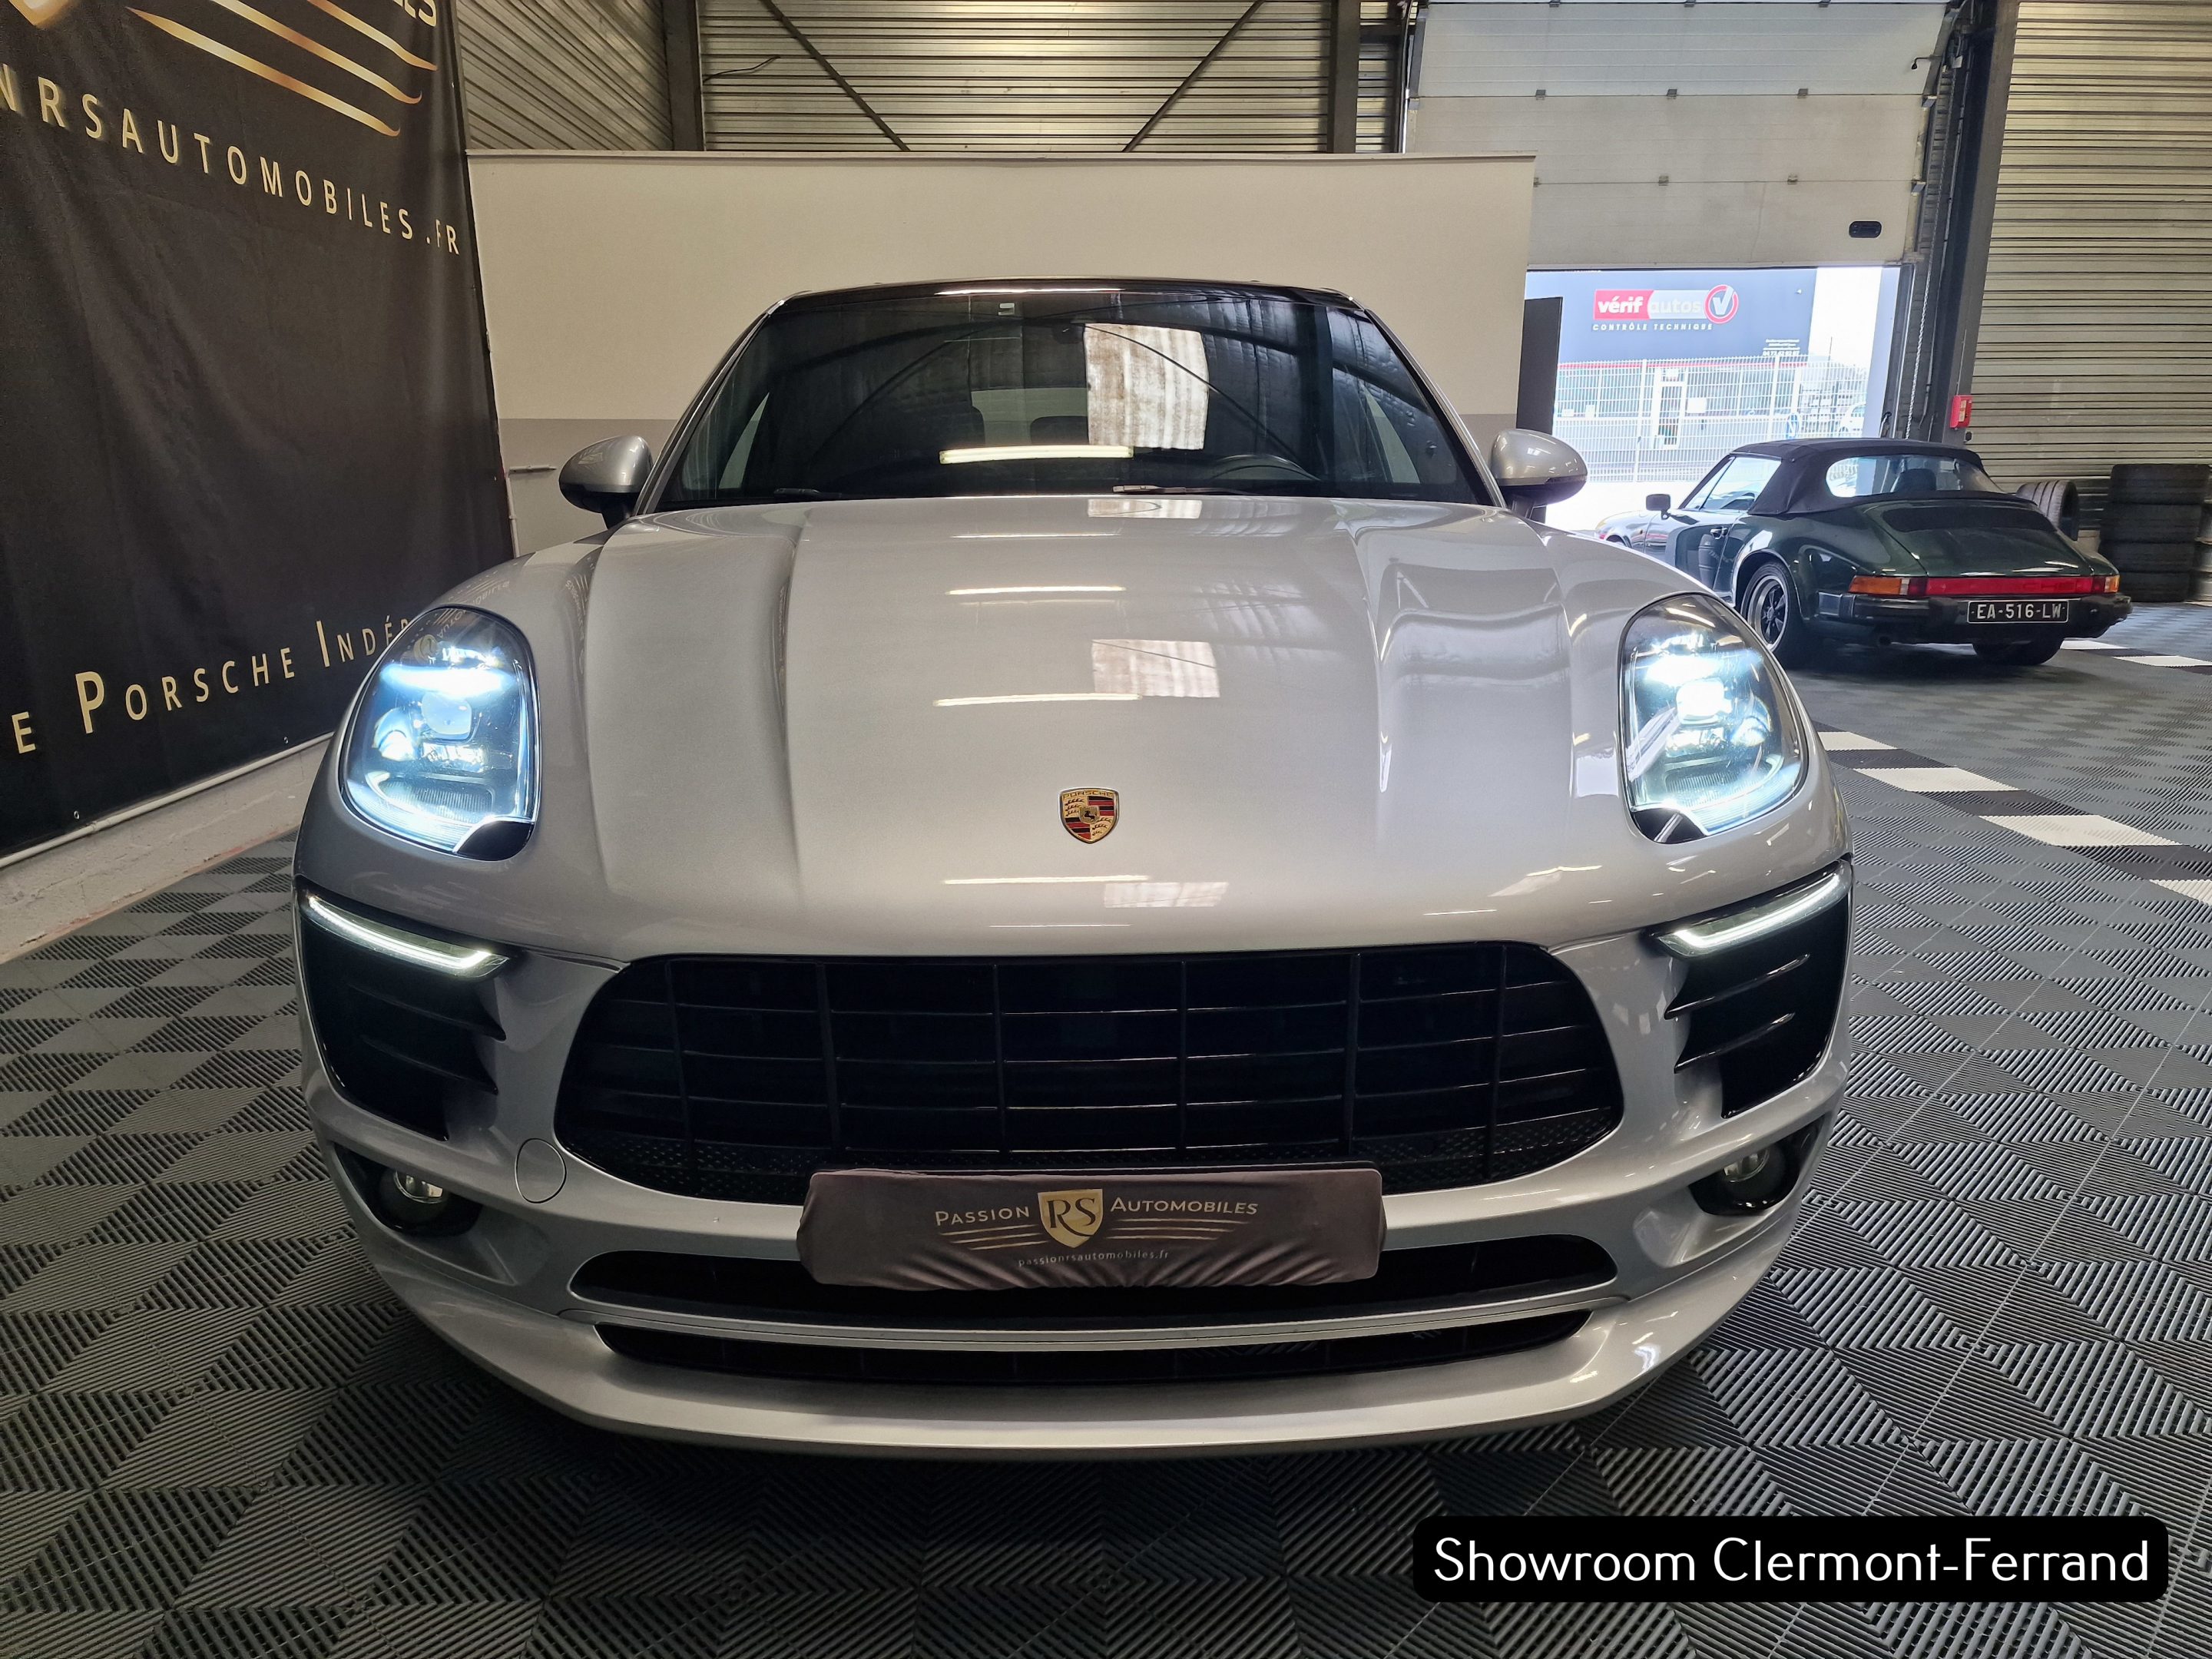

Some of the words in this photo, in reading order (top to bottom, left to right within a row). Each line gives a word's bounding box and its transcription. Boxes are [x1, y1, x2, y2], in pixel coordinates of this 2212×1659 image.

[1598, 296, 1644, 313] vérif
[1651, 298, 1702, 314] autos
[1592, 322, 1647, 331] CONTRÔLE
[1654, 323, 1713, 331] TECHNIQUE
[1976, 603, 2061, 620] EA-516-LW
[75, 647, 295, 734] PORSCHE
[935, 1205, 1030, 1227] PASSION
[1047, 1197, 1096, 1237] RS
[1110, 1197, 1260, 1215] AUTOMOBILES
[1018, 1249, 1169, 1268] passionrsautomobiles.fr
